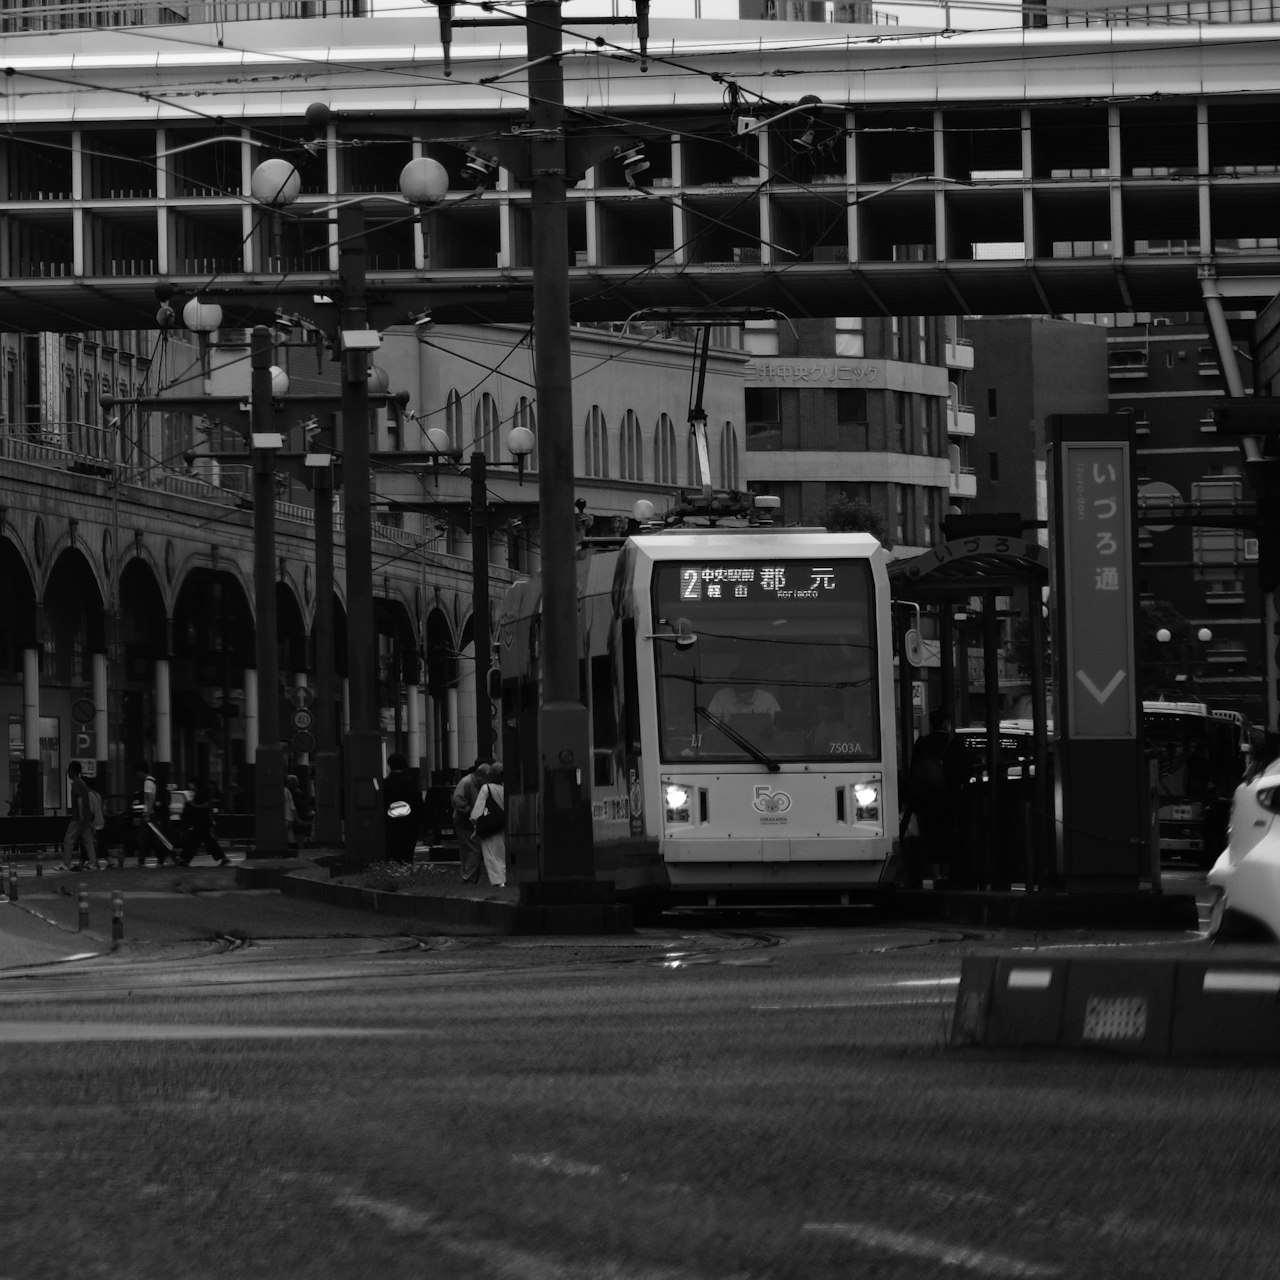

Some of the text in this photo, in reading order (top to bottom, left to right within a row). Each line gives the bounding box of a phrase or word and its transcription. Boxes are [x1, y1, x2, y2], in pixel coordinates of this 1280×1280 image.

[744, 365, 878, 382] 三井中央クリニック
[1094, 462, 1120, 591] いづろ通
[933, 537, 1041, 563] いづろ通
[683, 569, 699, 598] 2
[702, 568, 754, 582] 中央駅前
[76, 734, 90, 755] P
[830, 742, 862, 754] 7503A
